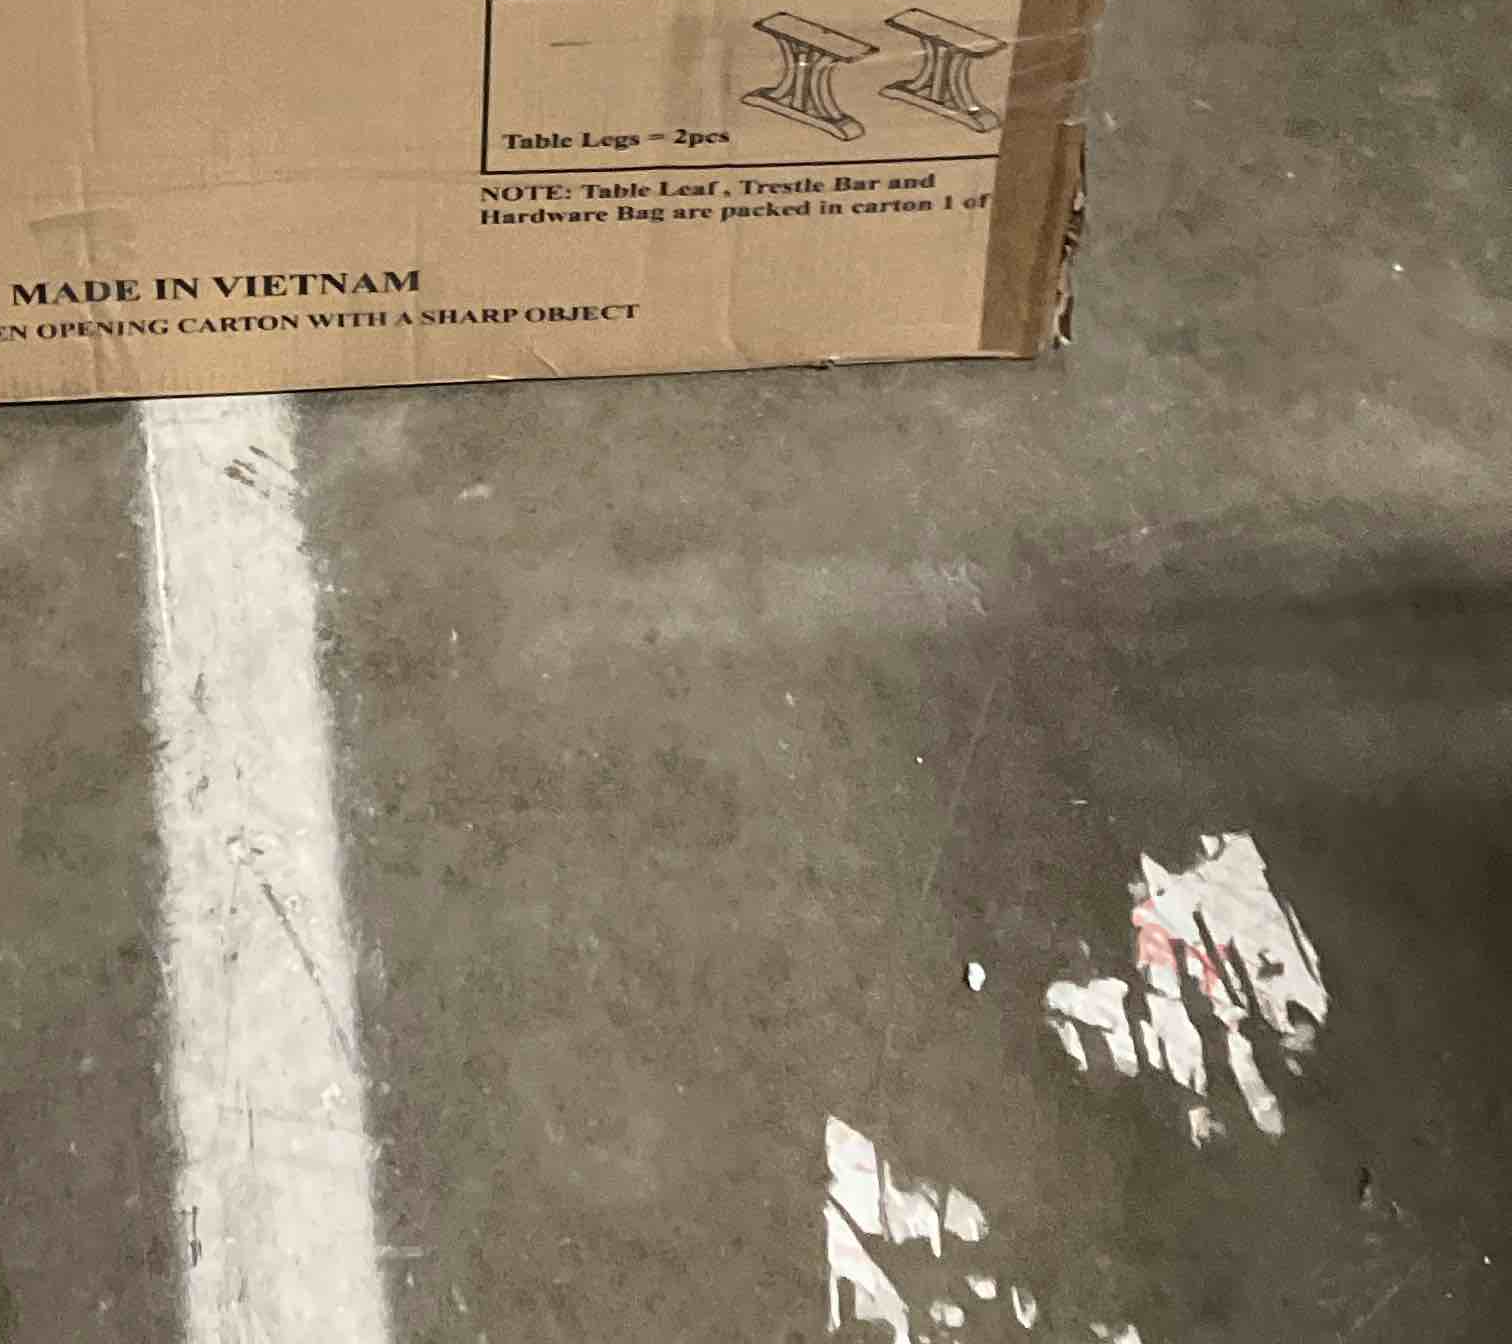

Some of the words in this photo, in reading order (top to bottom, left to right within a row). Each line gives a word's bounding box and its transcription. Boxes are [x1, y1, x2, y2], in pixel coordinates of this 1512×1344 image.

[502, 130, 572, 151] Table
[581, 129, 640, 153] Legs
[672, 127, 730, 150] 2pcs
[481, 184, 572, 204] NOTE:
[580, 181, 652, 202] Table
[739, 177, 825, 197] Trestle
[834, 174, 883, 194] Bar
[887, 172, 936, 191] and
[480, 207, 608, 226] Hardware
[617, 205, 666, 224] Bag
[672, 205, 715, 221] are
[720, 200, 811, 223] packed
[819, 198, 844, 215] in
[851, 197, 933, 216] carton
[962, 192, 992, 211] of
[9, 278, 141, 306] MADE
[156, 275, 208, 301] IN
[214, 269, 422, 299] VIETNAM
[36, 317, 170, 342] OPENING
[177, 313, 299, 336] CARTON
[308, 309, 387, 332] WITH
[392, 308, 414, 328] A
[420, 305, 519, 327] SHARP
[524, 302, 641, 325] OBJECT
